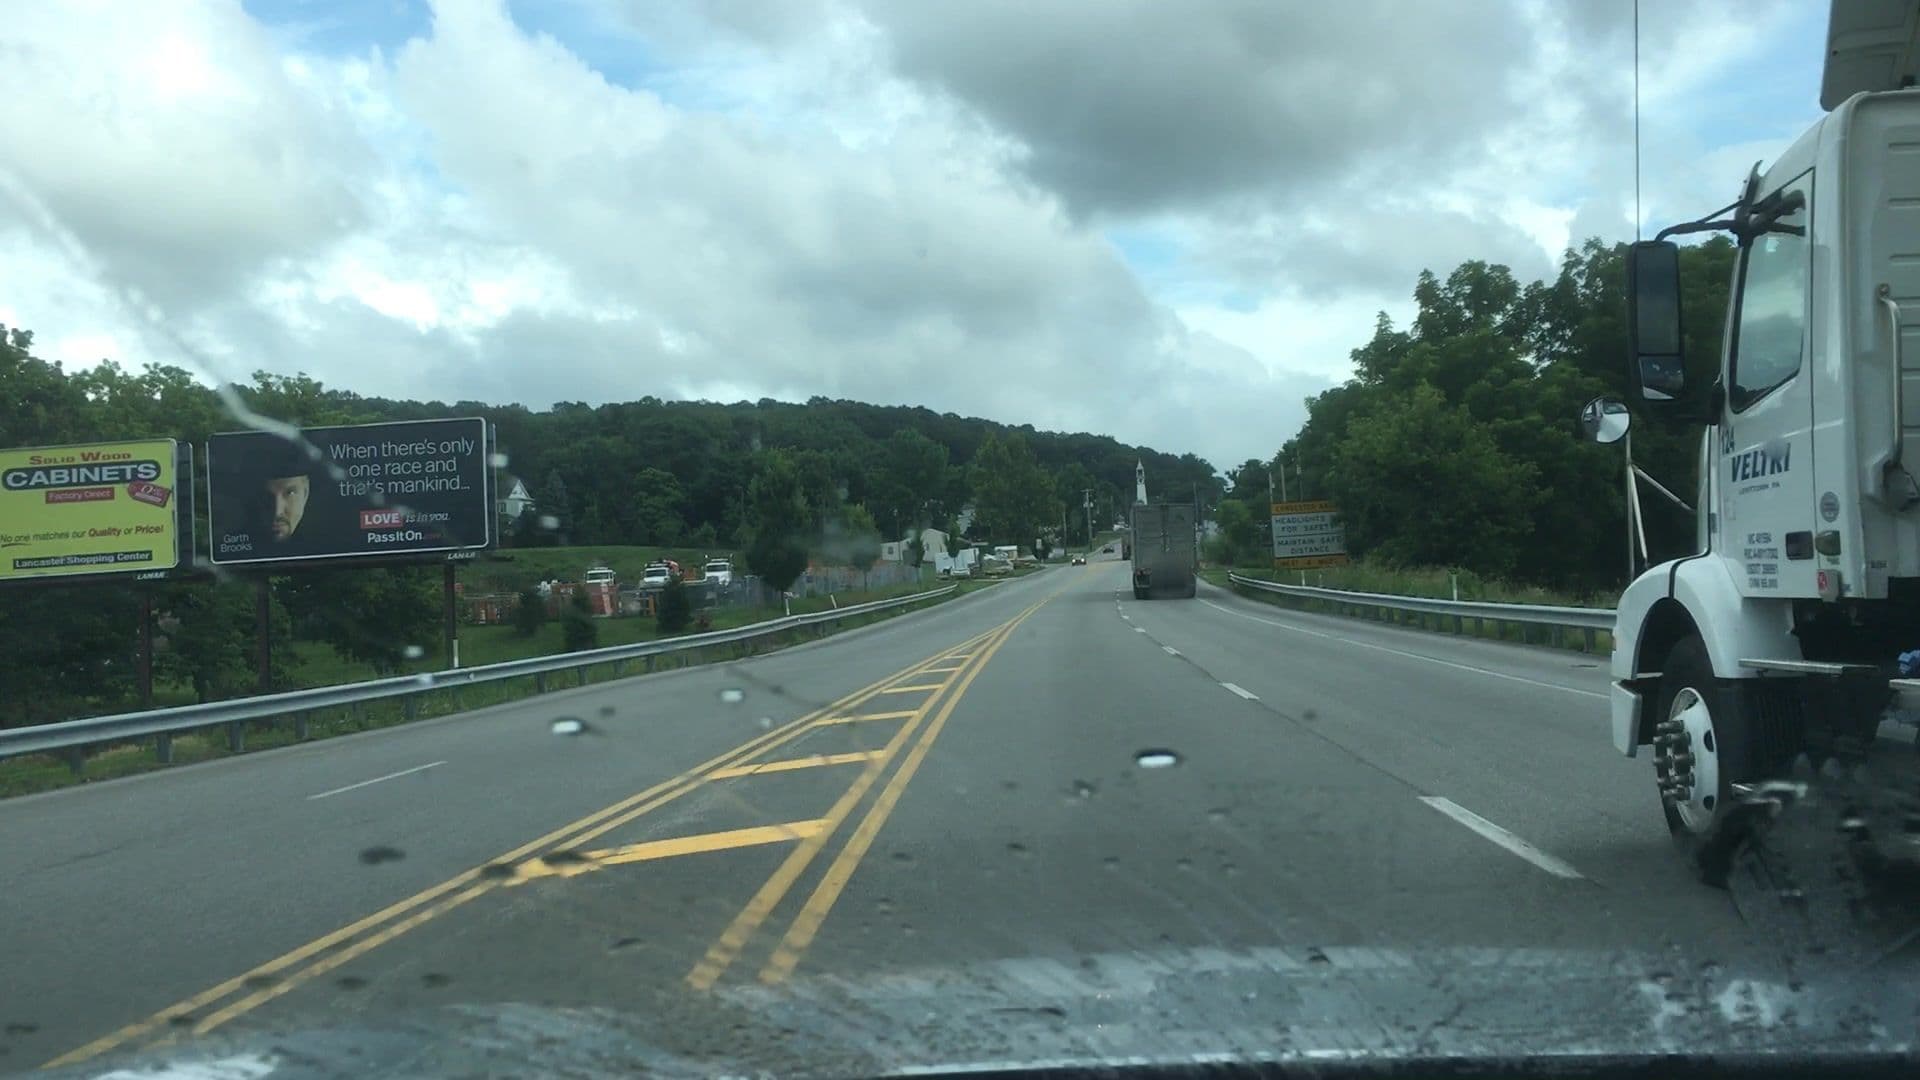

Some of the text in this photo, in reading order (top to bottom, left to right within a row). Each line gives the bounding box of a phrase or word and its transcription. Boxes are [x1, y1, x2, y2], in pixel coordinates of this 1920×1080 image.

[330, 437, 474, 460] When there's only
[6, 463, 157, 487] CABINETS
[349, 457, 456, 477] one race and
[339, 475, 470, 497] that's mankind...
[364, 513, 400, 525] LOVE
[406, 512, 416, 522] is
[417, 512, 427, 521] in
[1, 534, 13, 542] No
[32, 531, 69, 541] matches
[88, 527, 121, 538] Quality
[224, 534, 249, 543] Garth
[220, 543, 252, 553] Brooks
[1290, 546, 1330, 555] DISTANCE
[16, 551, 149, 568] Lancaster Shopping Center
